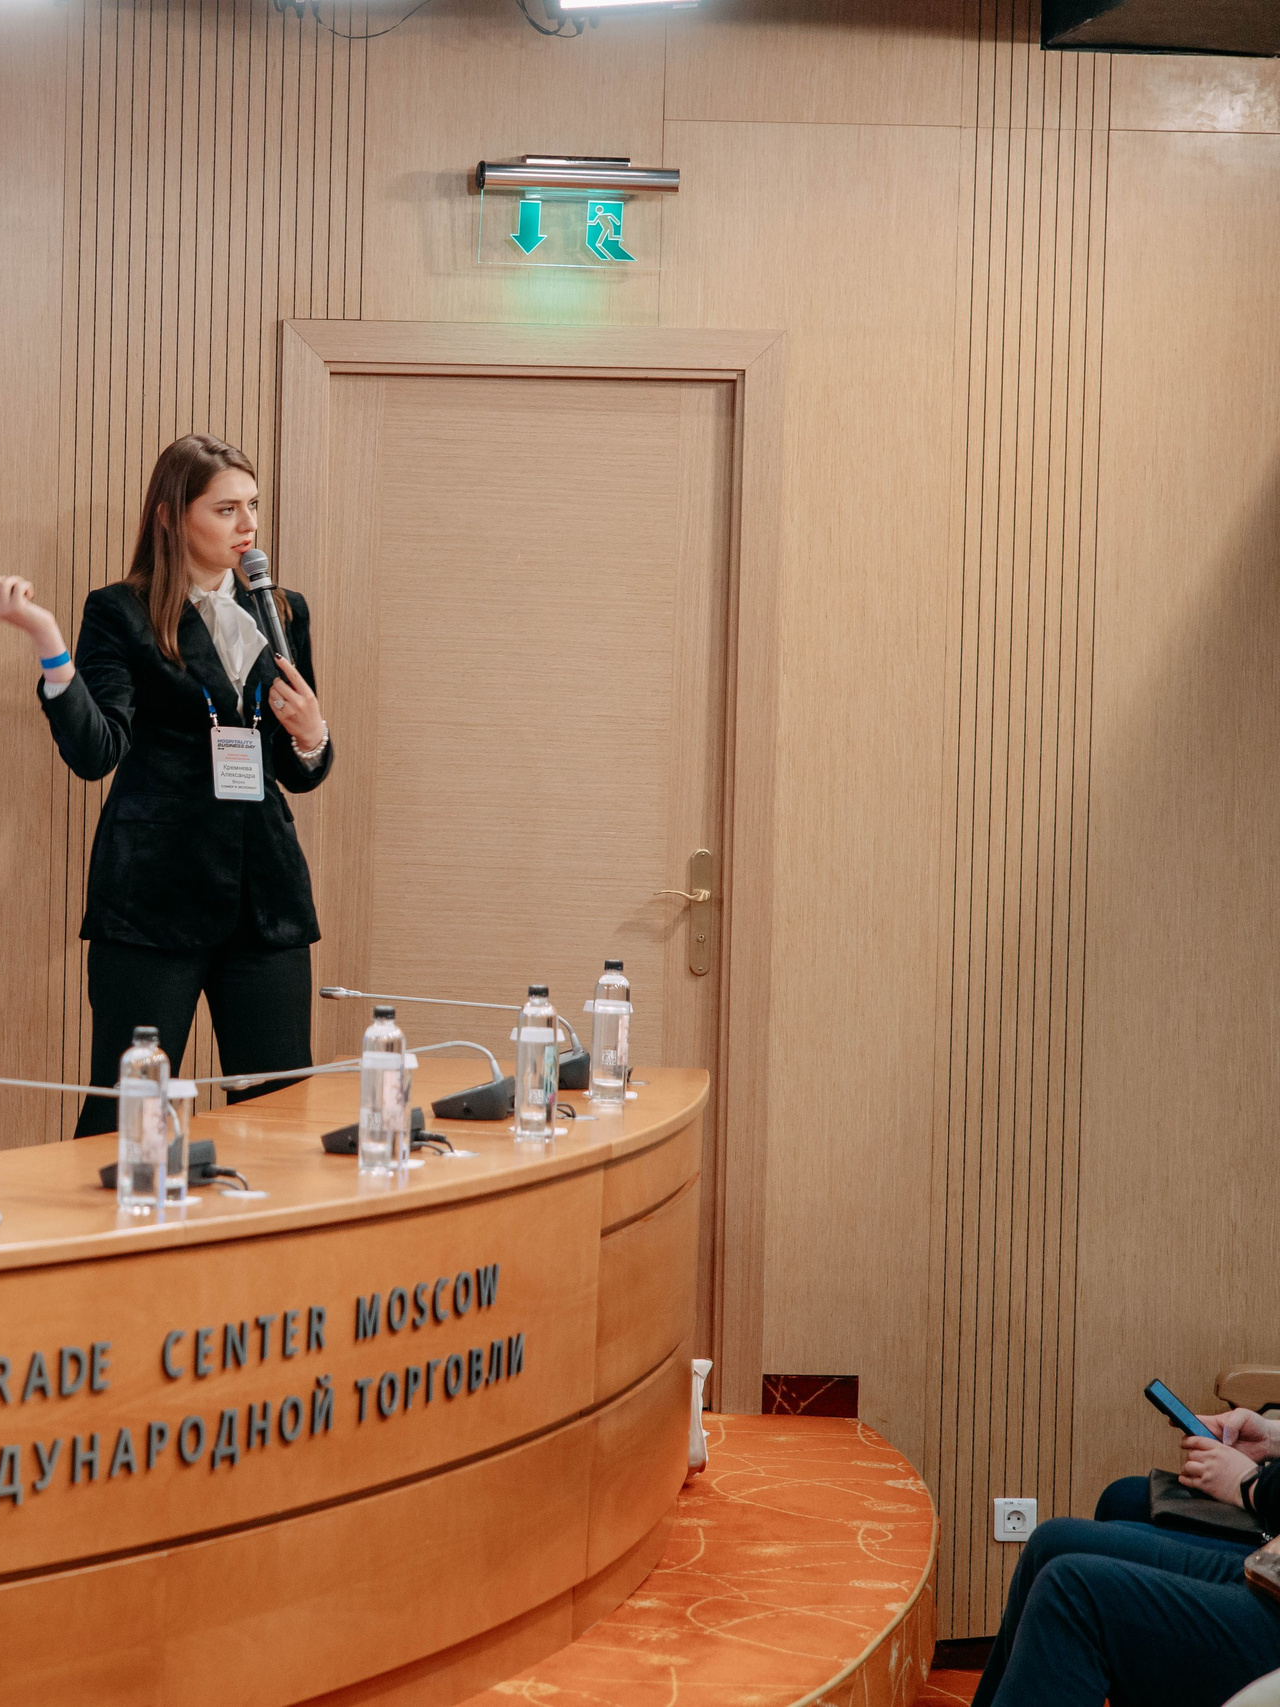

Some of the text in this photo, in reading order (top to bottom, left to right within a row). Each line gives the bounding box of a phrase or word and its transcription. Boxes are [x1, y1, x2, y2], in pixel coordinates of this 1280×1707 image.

[221, 771, 256, 779] Александра
[162, 1305, 327, 1379] CENTER
[355, 1263, 500, 1341] MOSCOW
[354, 1332, 526, 1425] ТОРГОВЛИ
